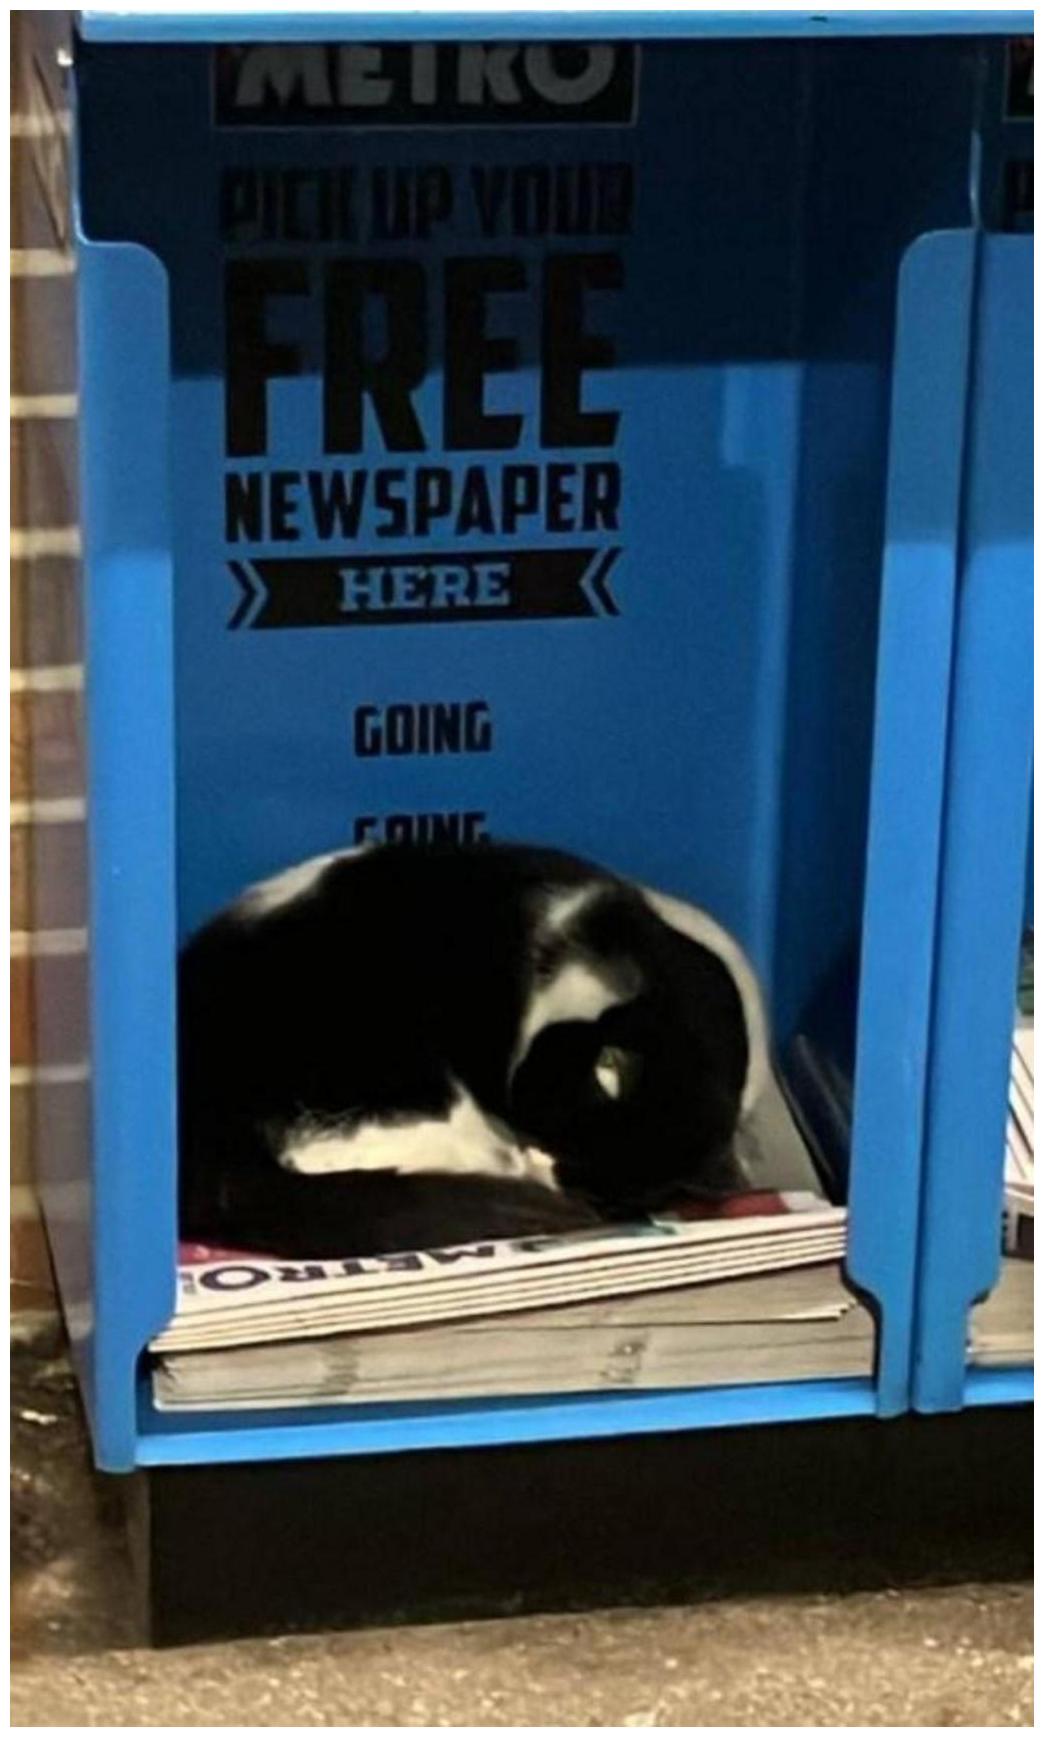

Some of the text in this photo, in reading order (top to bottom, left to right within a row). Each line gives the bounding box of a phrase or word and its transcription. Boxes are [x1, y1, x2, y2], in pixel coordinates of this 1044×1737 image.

[234, 44, 615, 106] METRO
[223, 161, 635, 240] PICK UP YOUR
[226, 254, 621, 456] FREE
[225, 462, 621, 543] NEWSPAPER
[339, 562, 512, 613] HERE
[354, 701, 492, 758] GOING
[200, 1242, 496, 1292] METRO
